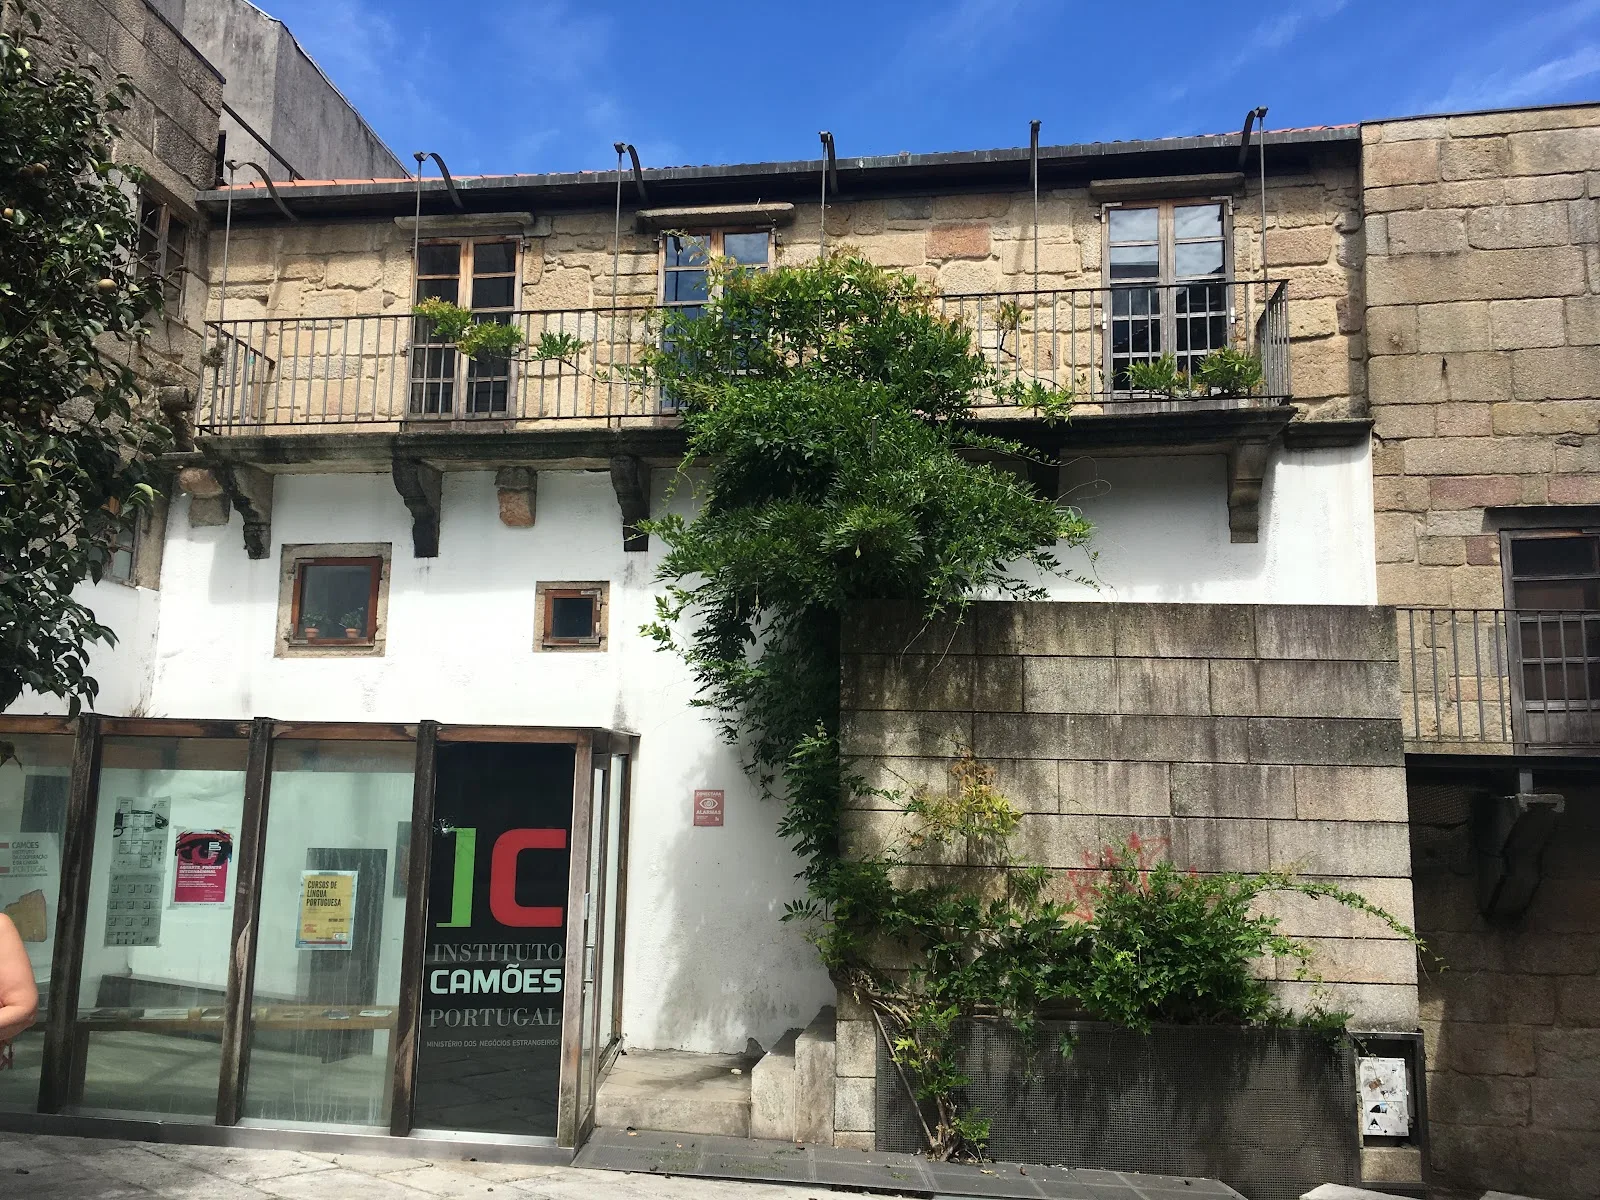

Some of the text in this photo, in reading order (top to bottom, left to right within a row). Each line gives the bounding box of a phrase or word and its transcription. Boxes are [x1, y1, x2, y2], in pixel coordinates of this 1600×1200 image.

[307, 881, 337, 889] CURSOS DE
[306, 898, 341, 907] PORTUGUESA
[433, 943, 563, 962] INSTITUTO
[430, 963, 562, 994] CAMÕES
[428, 1007, 560, 1028] PORTUGAL
[426, 1039, 463, 1048] MINISTÉRIO
[479, 1038, 511, 1047] NEGÓCIOS
[512, 1038, 559, 1047] ESTRANGEIROS
